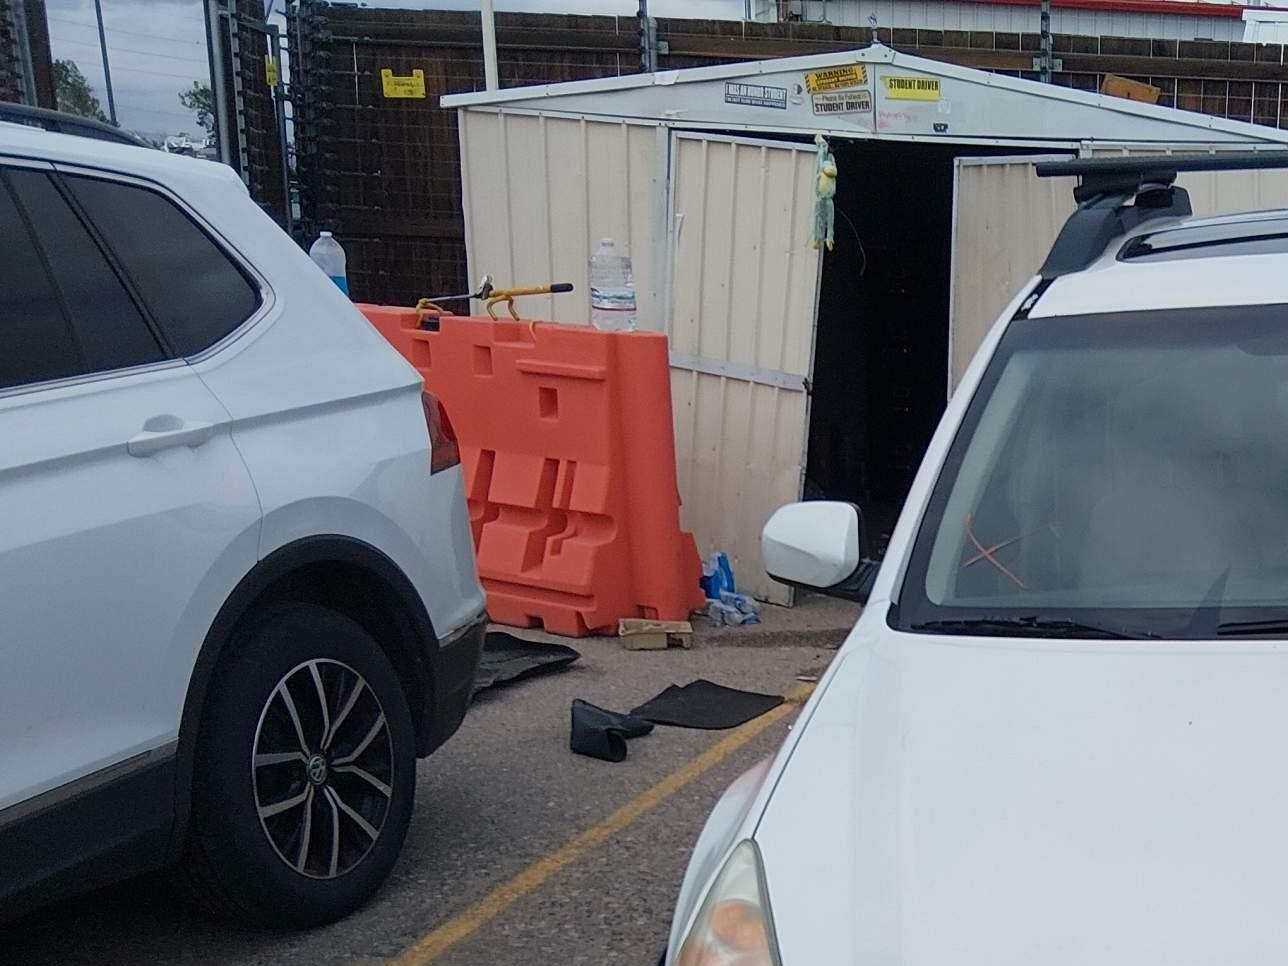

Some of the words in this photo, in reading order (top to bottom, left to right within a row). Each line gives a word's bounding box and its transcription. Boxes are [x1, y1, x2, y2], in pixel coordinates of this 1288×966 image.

[815, 67, 854, 79] WARNING
[889, 79, 916, 88] STUDENT
[917, 80, 938, 90] DRIVER
[815, 102, 844, 112] STUDENT
[846, 101, 870, 111] DRIVER
